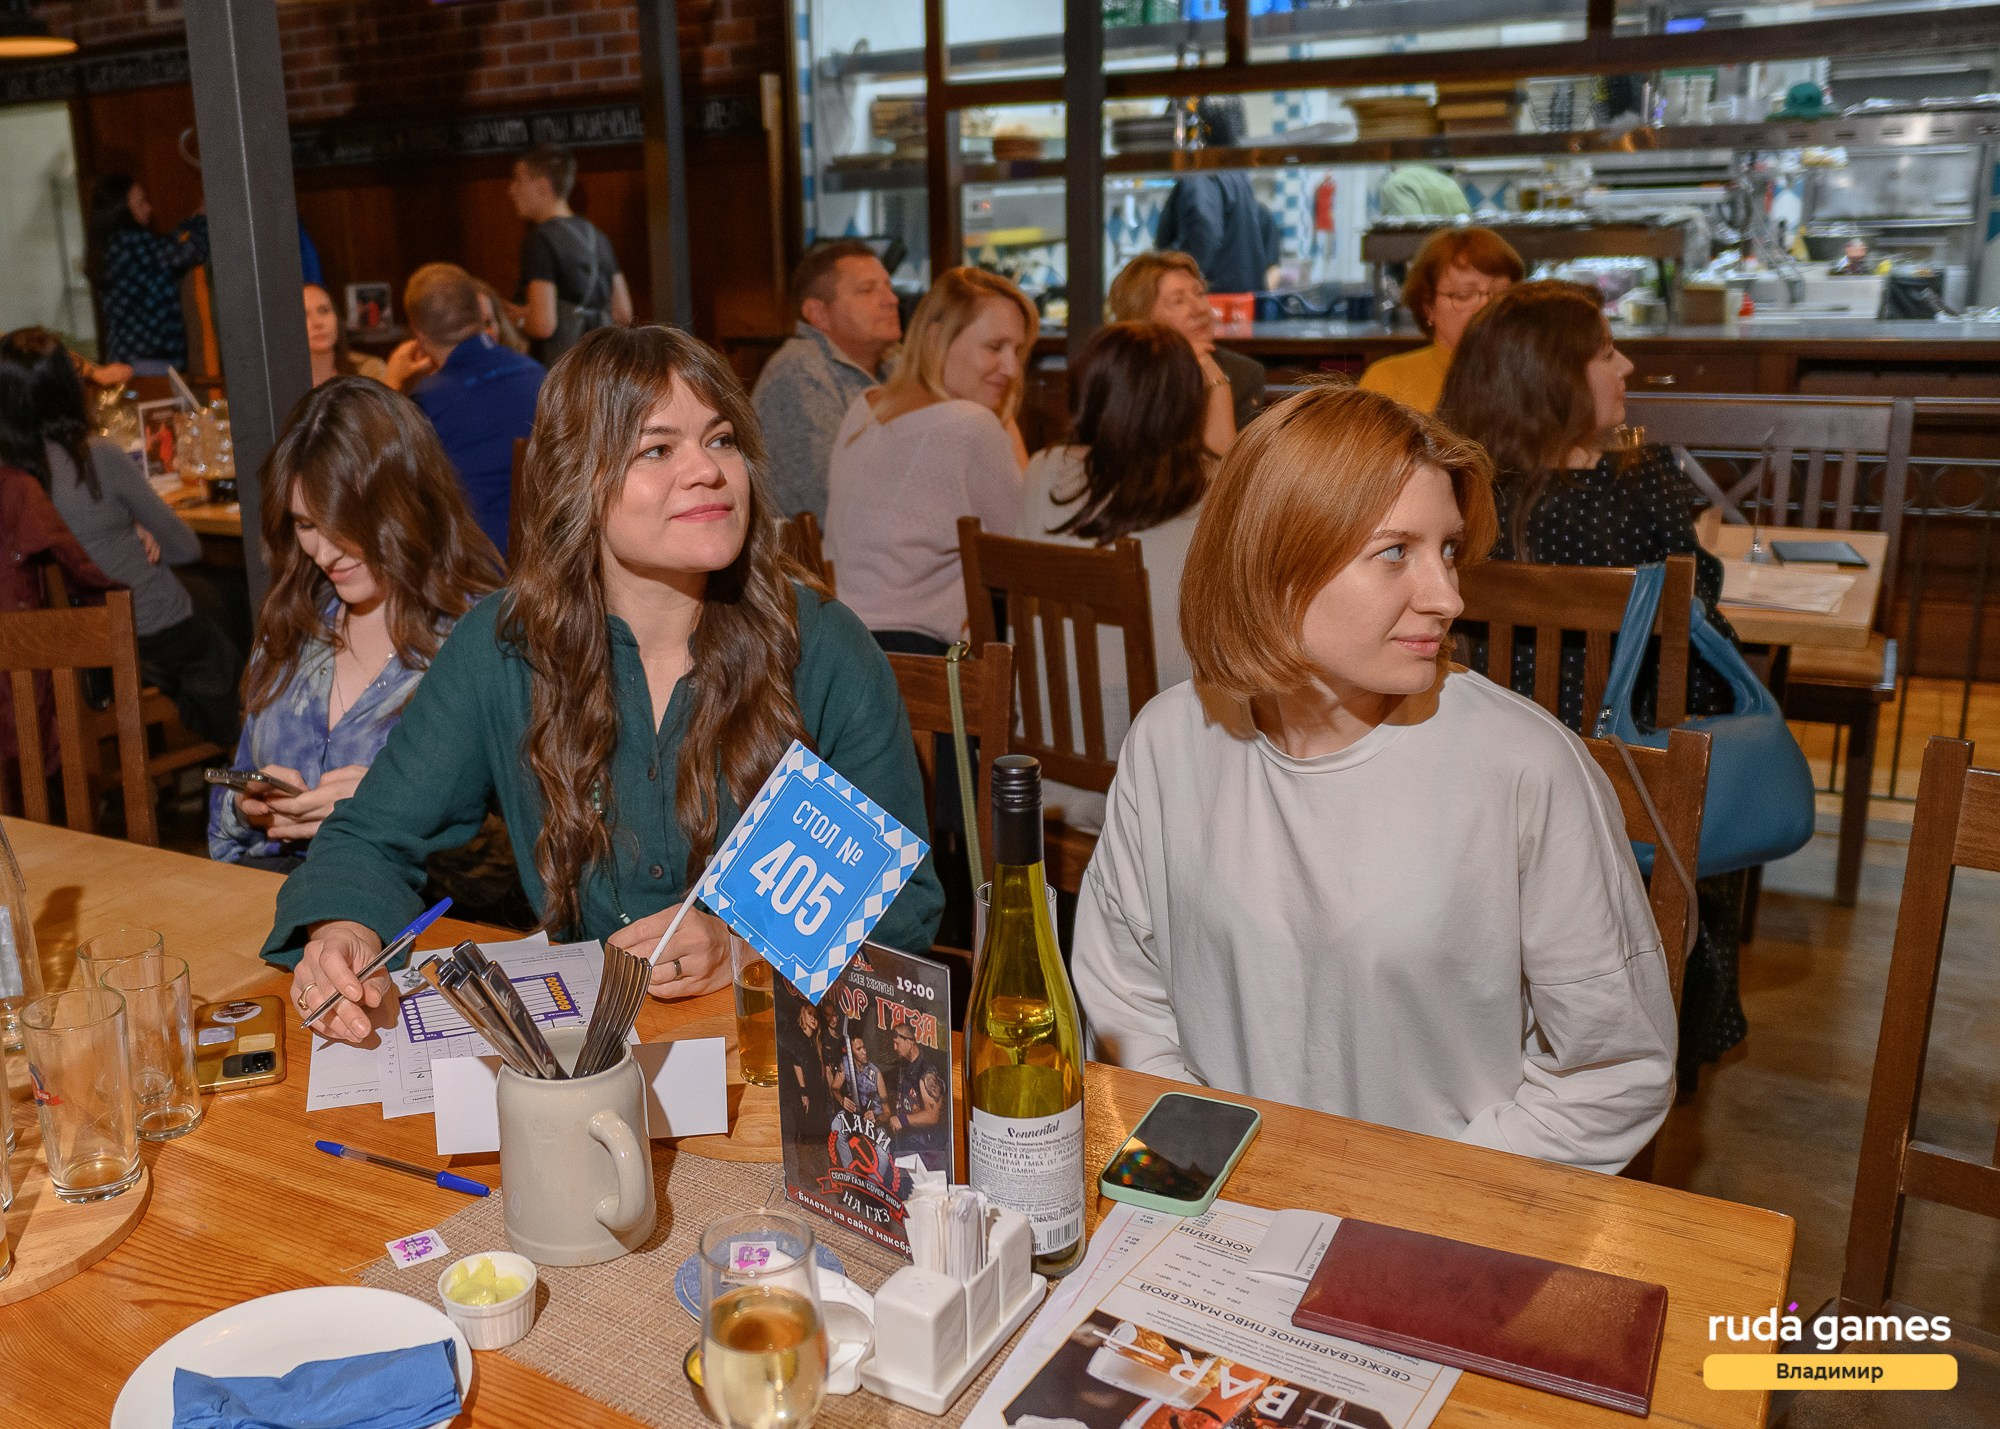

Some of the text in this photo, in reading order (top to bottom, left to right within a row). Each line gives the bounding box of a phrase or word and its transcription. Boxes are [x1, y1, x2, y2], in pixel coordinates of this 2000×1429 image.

[792, 800, 864, 867] СТОЛ №
[748, 839, 846, 936] 405
[866, 976, 895, 996] ХИТЫ
[896, 975, 935, 1000] 19:00
[874, 996, 938, 1050] ГАЗА
[837, 1112, 892, 1152] ДАВИ
[1007, 1120, 1060, 1138] Sonnental
[842, 1190, 891, 1224] НА ГАЗ
[851, 1175, 866, 1188] ГАЗА
[866, 1183, 885, 1198] COVER
[884, 1194, 902, 1210] SHOW
[798, 1190, 912, 1254] Билеты на сайте максбр
[1178, 1225, 1252, 1254] КОКТЕЙЛИ
[1140, 1282, 1179, 1302] БРОЙ
[1180, 1298, 1222, 1318] МАКС
[1224, 1312, 1267, 1333] ПИВО
[1268, 1327, 1412, 1384] СВЕЖЕСВАРЕННОЕ
[1170, 1348, 1300, 1420] BAR
